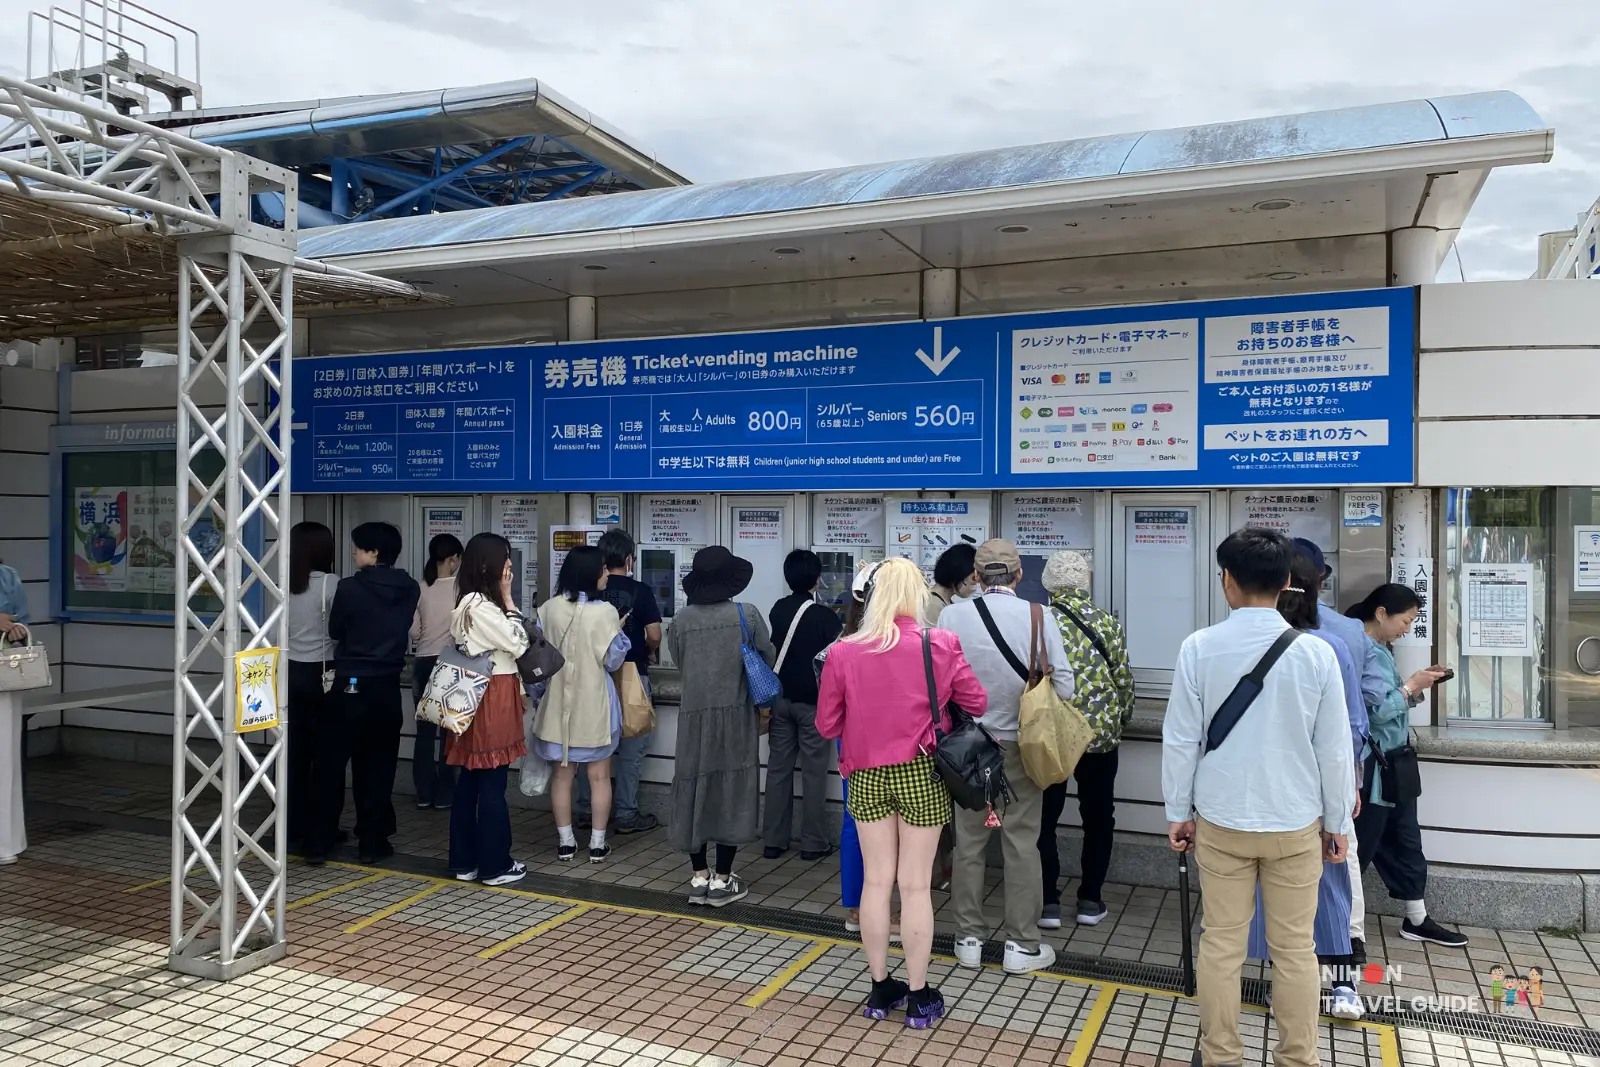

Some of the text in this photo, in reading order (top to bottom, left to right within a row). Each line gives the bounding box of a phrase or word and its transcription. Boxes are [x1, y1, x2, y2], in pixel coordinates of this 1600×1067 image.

[1251, 318, 1340, 335] 障害者手帳を
[1020, 330, 1189, 348] クレジットカード・電子マネーが
[1237, 334, 1355, 351] お持ちのお客様へ
[1072, 346, 1132, 355] ご利用いただけます
[633, 345, 858, 370] Ticket-vending machine
[544, 356, 627, 389] 券売機
[1021, 376, 1042, 385] VISA
[313, 381, 479, 399] お求めの方は窓口をご利用ください
[1219, 381, 1372, 396] ご本人とお付添いの方1名様が
[1249, 396, 1338, 408] 無料となりますので
[345, 411, 365, 420] 2日券
[405, 408, 445, 419] 団体入園券
[456, 406, 512, 417] 年間パスポート
[816, 403, 974, 427] シルバー Seniors 560円
[416, 421, 435, 429] Group
[464, 420, 487, 428] Annual
[706, 414, 736, 426] Adults
[748, 410, 801, 431] 800円
[337, 424, 354, 432] 2-day
[551, 424, 603, 439] 入園料金
[619, 421, 643, 432] 1日券
[105, 424, 195, 443] informatin
[619, 434, 642, 442] General
[1225, 427, 1368, 442] ペットをお連れの方へ
[554, 443, 584, 451] Admission
[659, 454, 961, 469] 中学生以下は無料 Children (junior high school students and under) are Free
[1229, 451, 1361, 462] ペットのご入園は無料です
[318, 463, 343, 471] シルバー
[903, 503, 965, 512] 持ち込み禁止品
